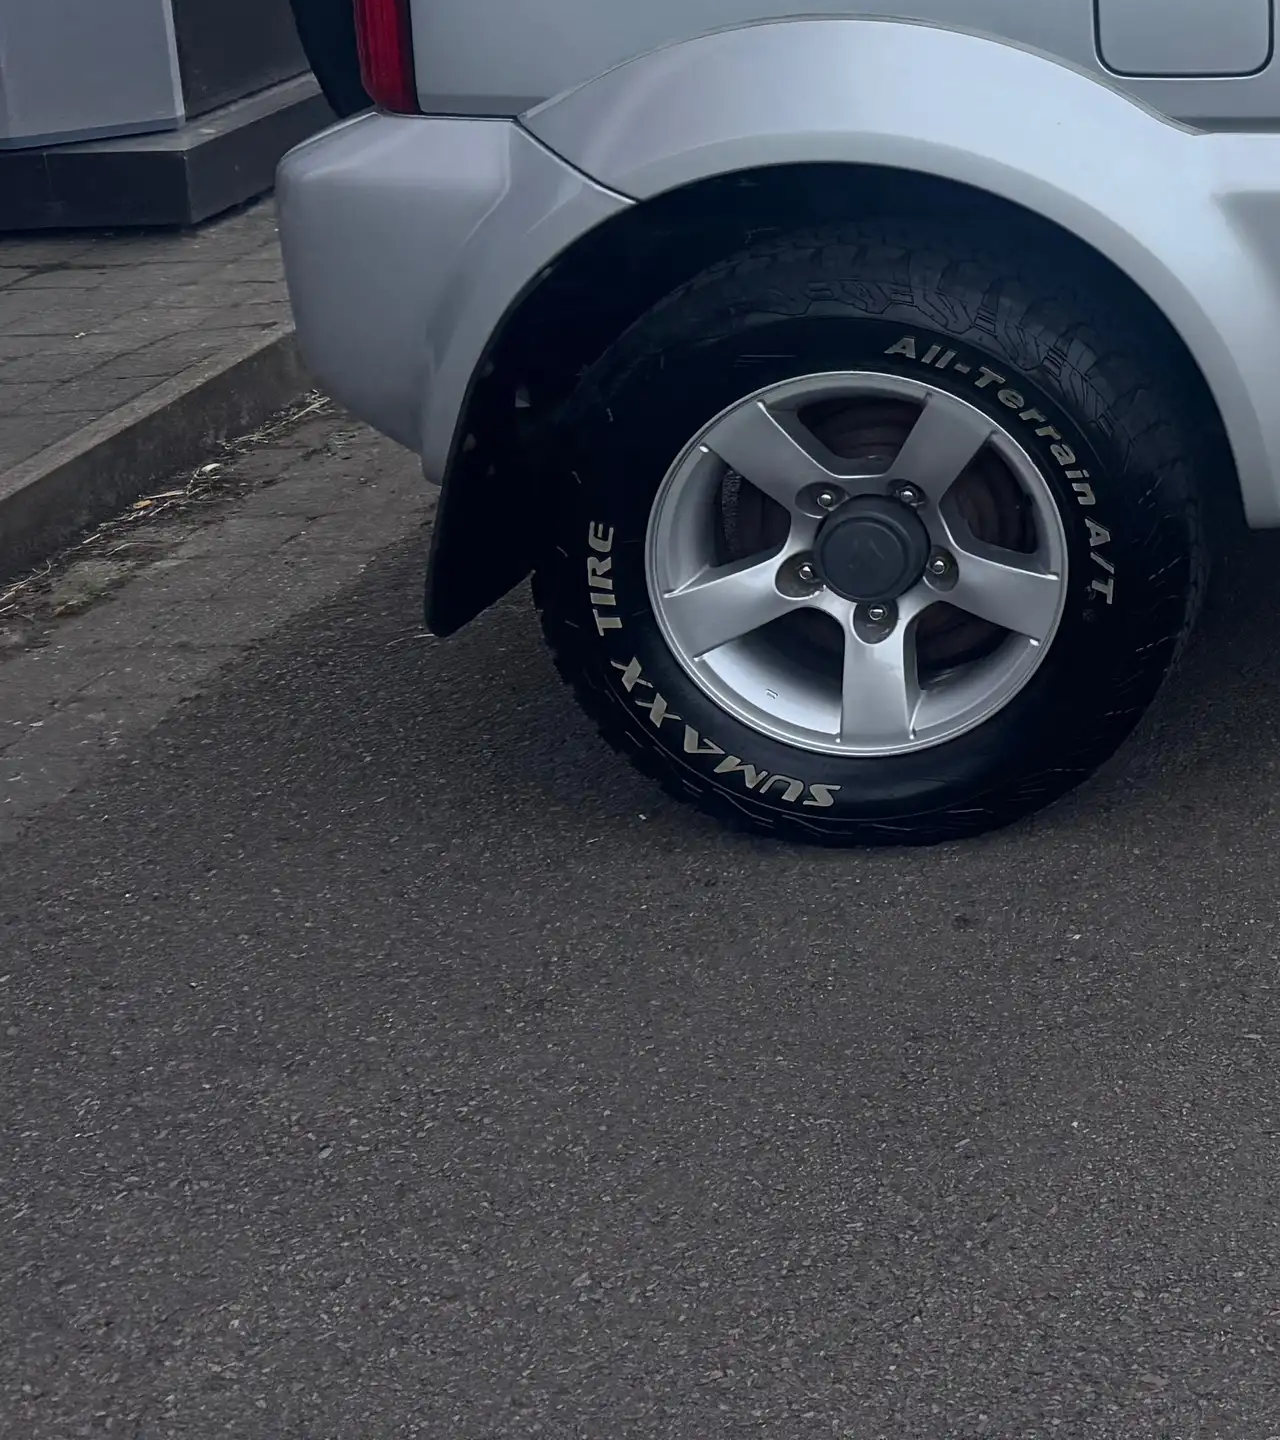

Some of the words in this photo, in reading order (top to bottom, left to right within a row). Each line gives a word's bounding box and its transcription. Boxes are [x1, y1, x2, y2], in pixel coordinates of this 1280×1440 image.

[884, 336, 1096, 506] All-Terrain
[1084, 517, 1115, 604] A/T
[587, 520, 623, 636] TIRE
[610, 656, 842, 807] SUMAXX
